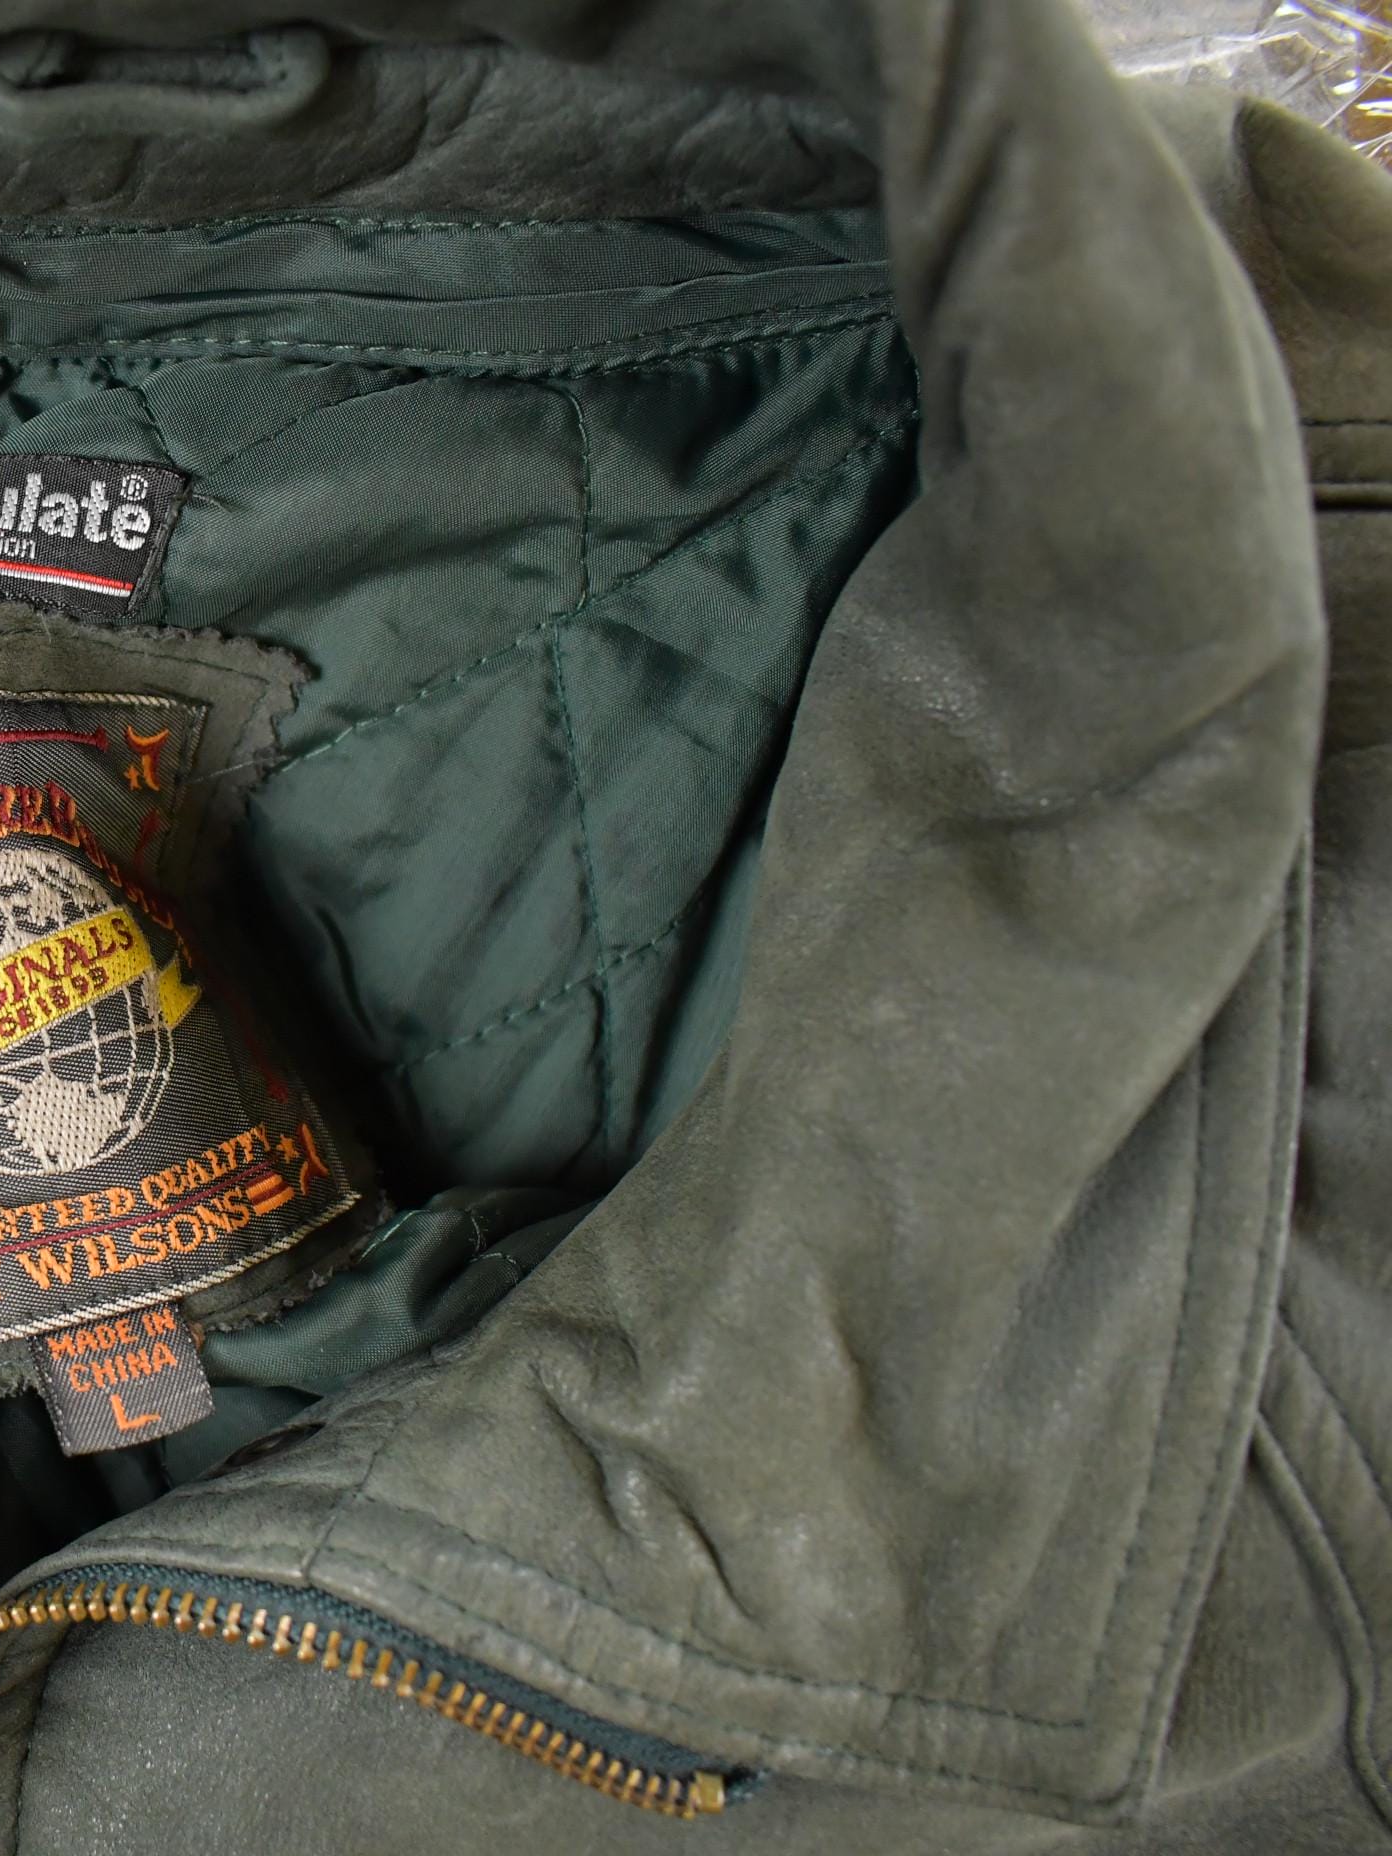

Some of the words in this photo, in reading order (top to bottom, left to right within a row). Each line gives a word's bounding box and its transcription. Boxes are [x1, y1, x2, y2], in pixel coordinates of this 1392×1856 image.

[141, 1124, 270, 1210] QUALITY
[16, 1187, 249, 1290] WILSONS
[47, 1319, 138, 1360] MADE
[142, 1308, 176, 1337] IN
[69, 1341, 176, 1393] CHINA
[111, 1393, 160, 1431] L
